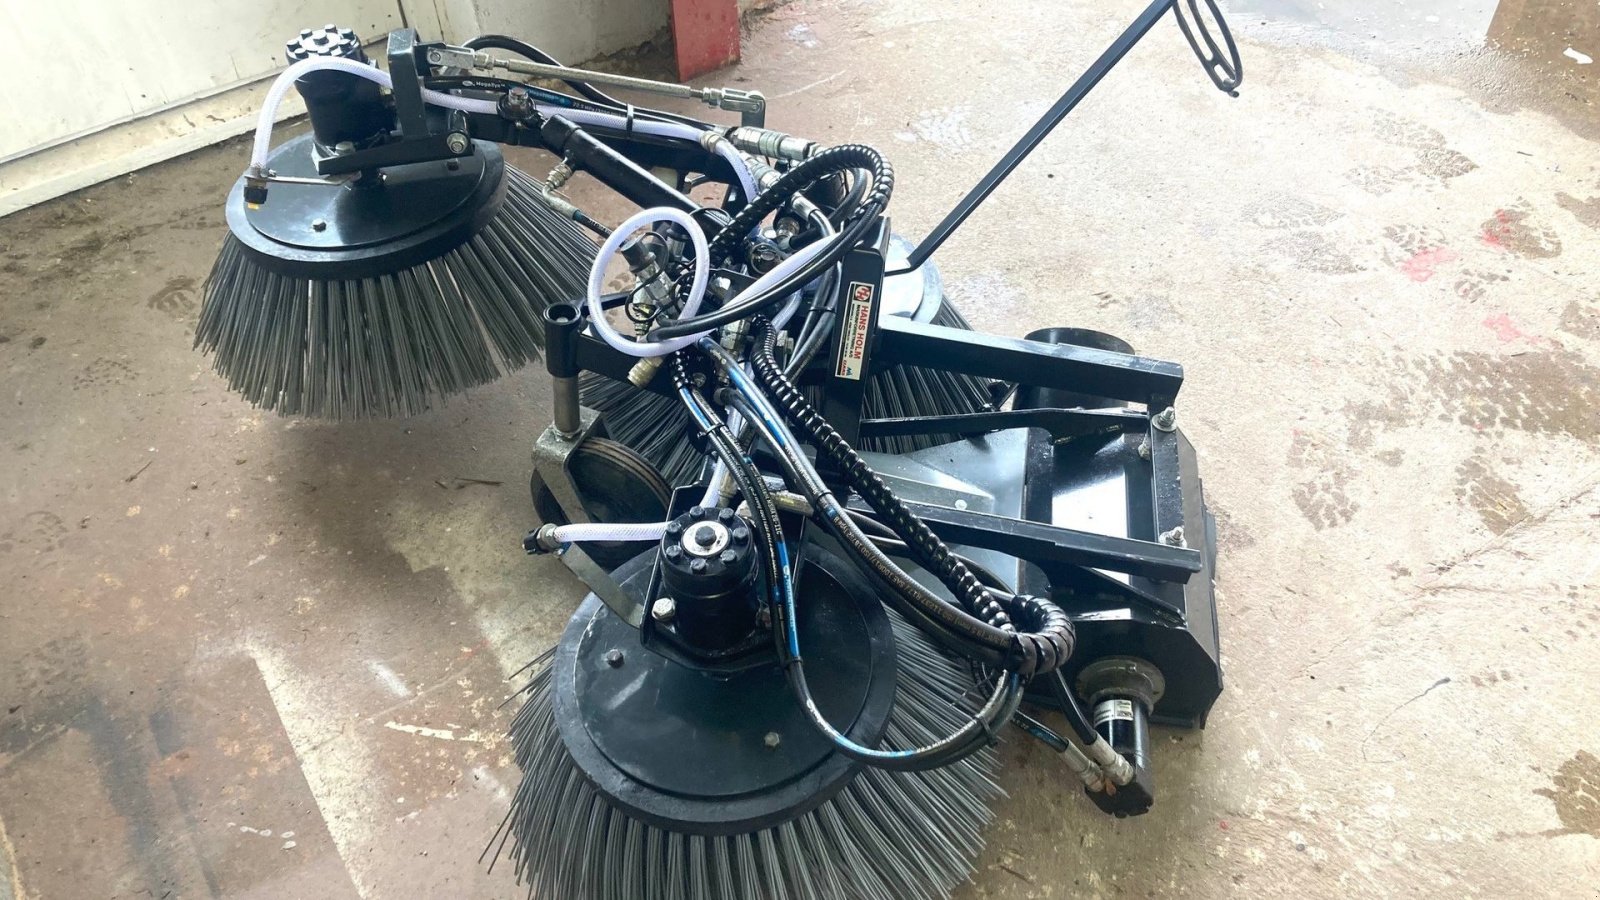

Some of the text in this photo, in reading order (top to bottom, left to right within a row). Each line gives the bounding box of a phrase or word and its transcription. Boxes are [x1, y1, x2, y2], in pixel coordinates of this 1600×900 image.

[854, 305, 868, 359] HANS HOLM
[891, 574, 906, 589] SAE
